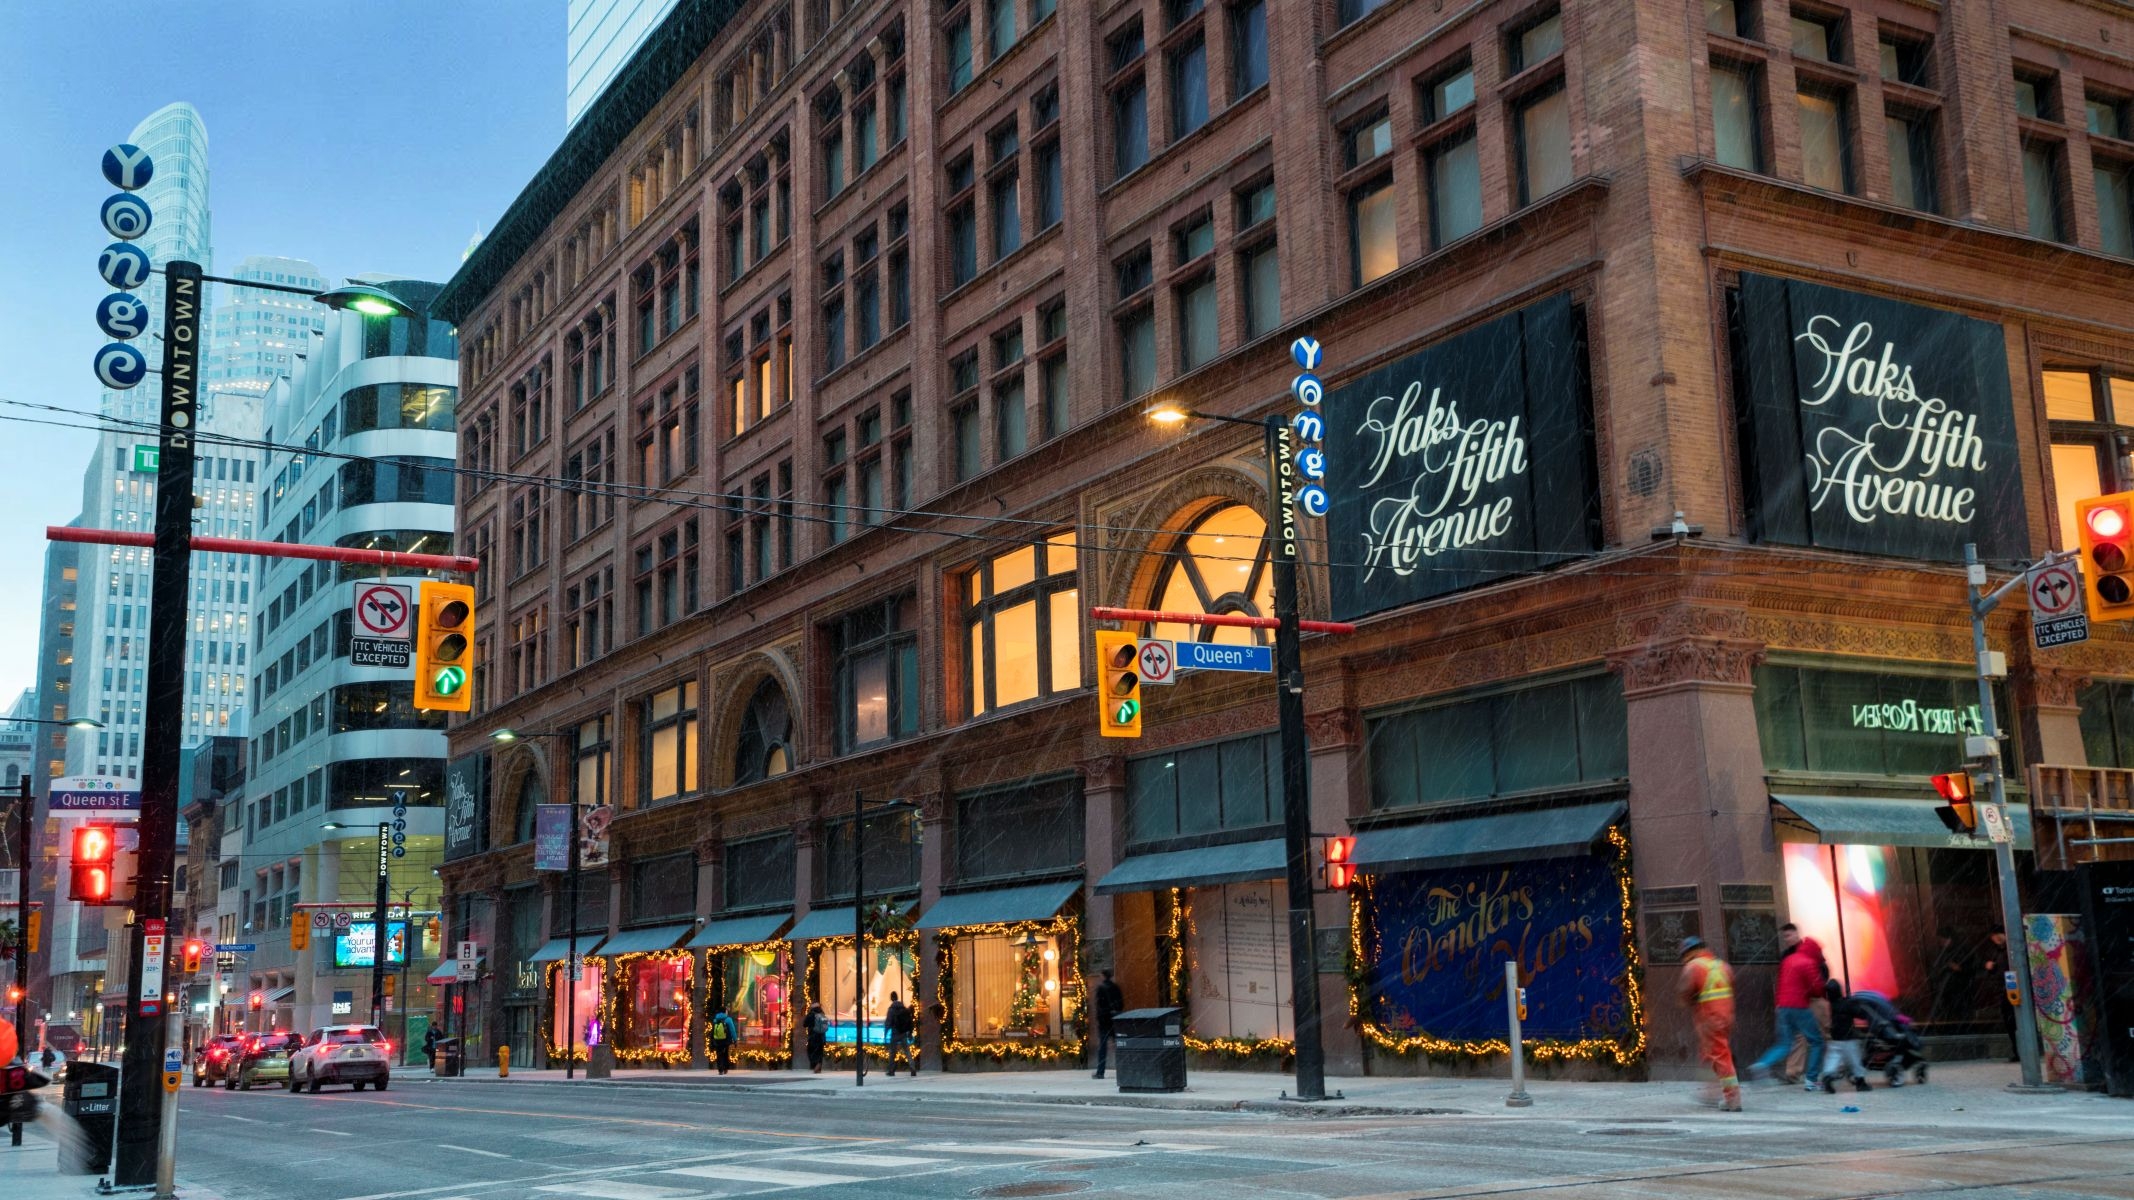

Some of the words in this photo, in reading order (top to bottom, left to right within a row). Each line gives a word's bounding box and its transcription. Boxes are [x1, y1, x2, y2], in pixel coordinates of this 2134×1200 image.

[171, 278, 194, 448] DOWNTOWN
[1794, 314, 1916, 405] Saks
[1356, 381, 1460, 488] Saks
[1865, 398, 1987, 477] Fifth
[1412, 418, 1528, 517] Fifth
[1806, 427, 1976, 523] Avenue
[1278, 428, 1296, 556] DOWNTOWN
[1360, 495, 1513, 584] Avenue
[354, 641, 370, 651] TTC
[373, 642, 409, 654] VEHICLES
[2036, 624, 2050, 635] TTC
[2052, 618, 2085, 632] VEHICLES
[2039, 629, 2085, 645] EXCEPTED
[355, 652, 406, 664] EXCEPTED
[1193, 645, 1243, 664] Queen
[1245, 648, 1254, 658] St
[62, 793, 105, 807] Queen
[110, 796, 119, 806] St
[123, 794, 130, 806] E
[380, 826, 388, 876] DOWNTOWN
[1427, 883, 1464, 926] The
[346, 938, 365, 946] Your
[89, 1102, 110, 1112] Litter
